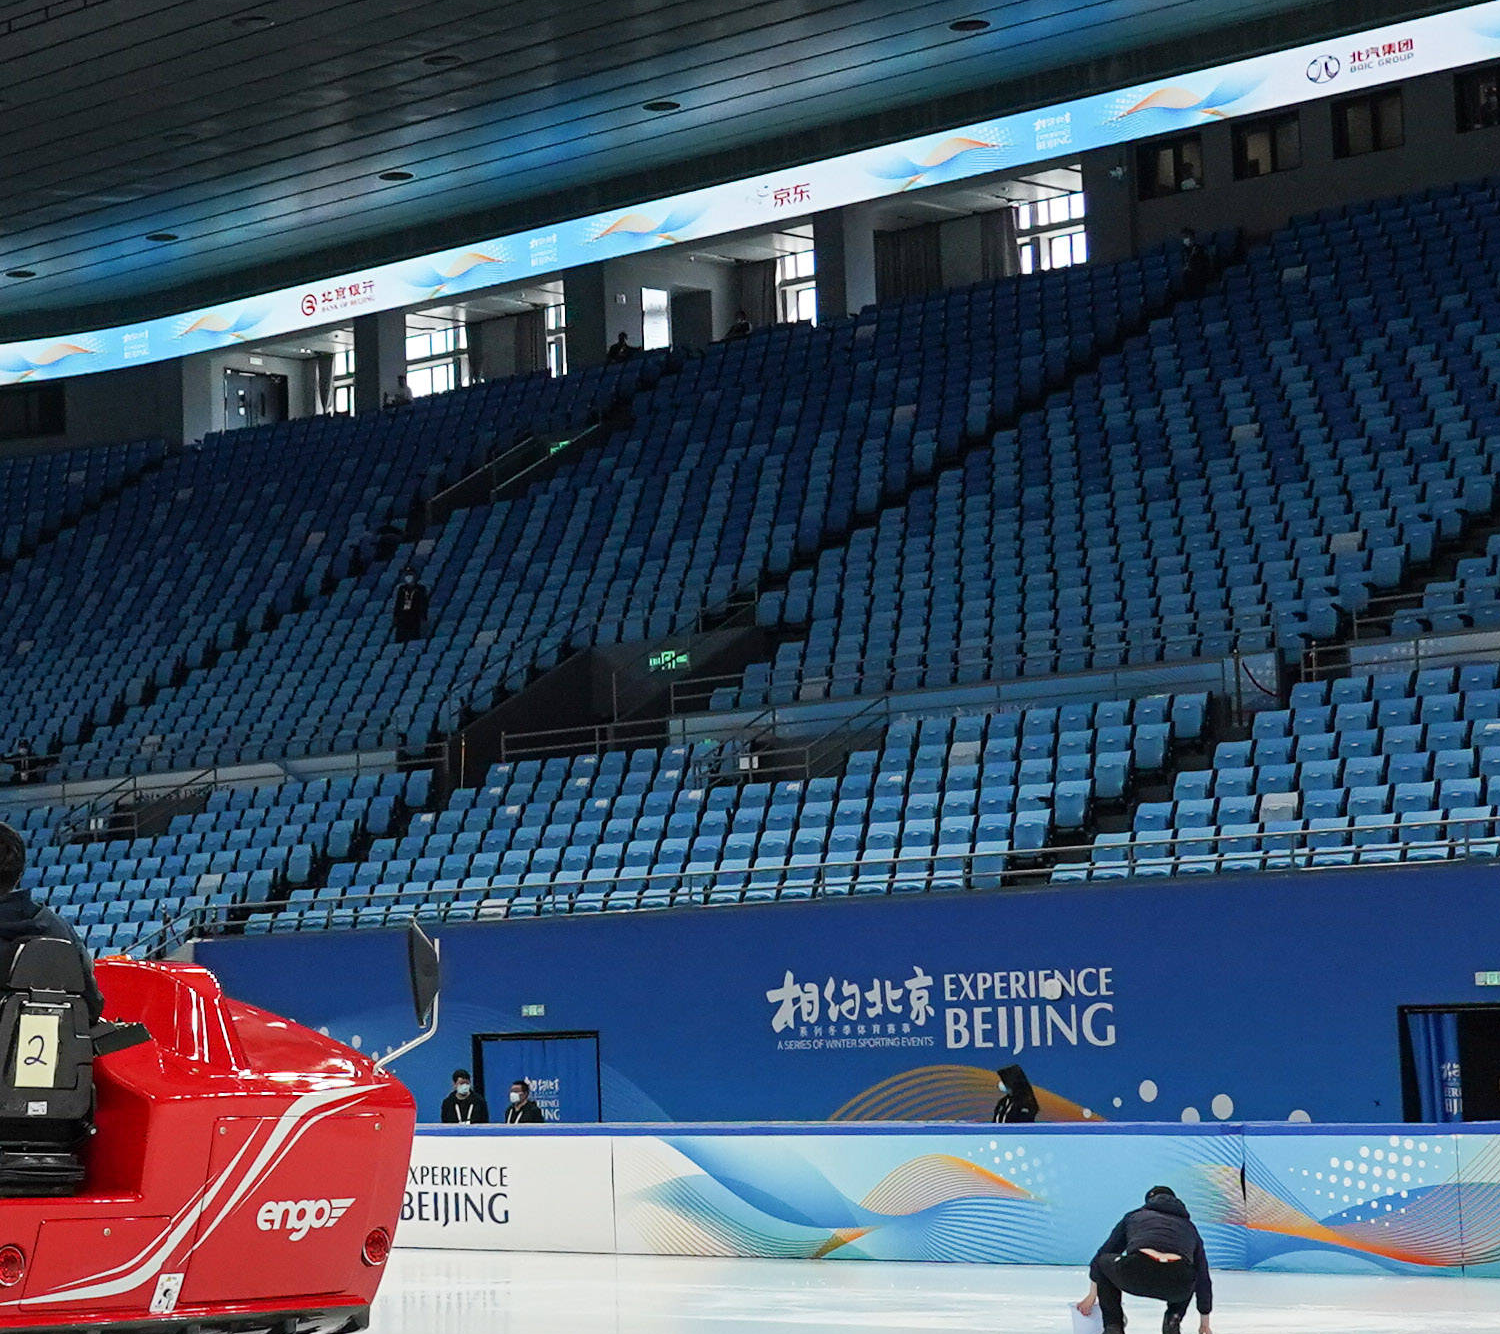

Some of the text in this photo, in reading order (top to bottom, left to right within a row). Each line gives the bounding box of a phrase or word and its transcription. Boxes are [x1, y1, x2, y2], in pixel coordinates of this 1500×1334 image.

[1349, 38, 1414, 64] 北汽集团
[773, 183, 811, 208] 京东
[766, 966, 935, 1034] 相约北京
[944, 967, 1114, 1001] EXPERIENCE
[777, 1035, 934, 1051] A SERIES OF WINTER SPORTING EVENTS
[945, 1002, 1116, 1055] BEIJING
[24, 1035, 48, 1065] 2
[408, 1166, 509, 1187] XPERIENCE
[257, 1199, 332, 1242] engo
[401, 1191, 510, 1227] BEIJING
